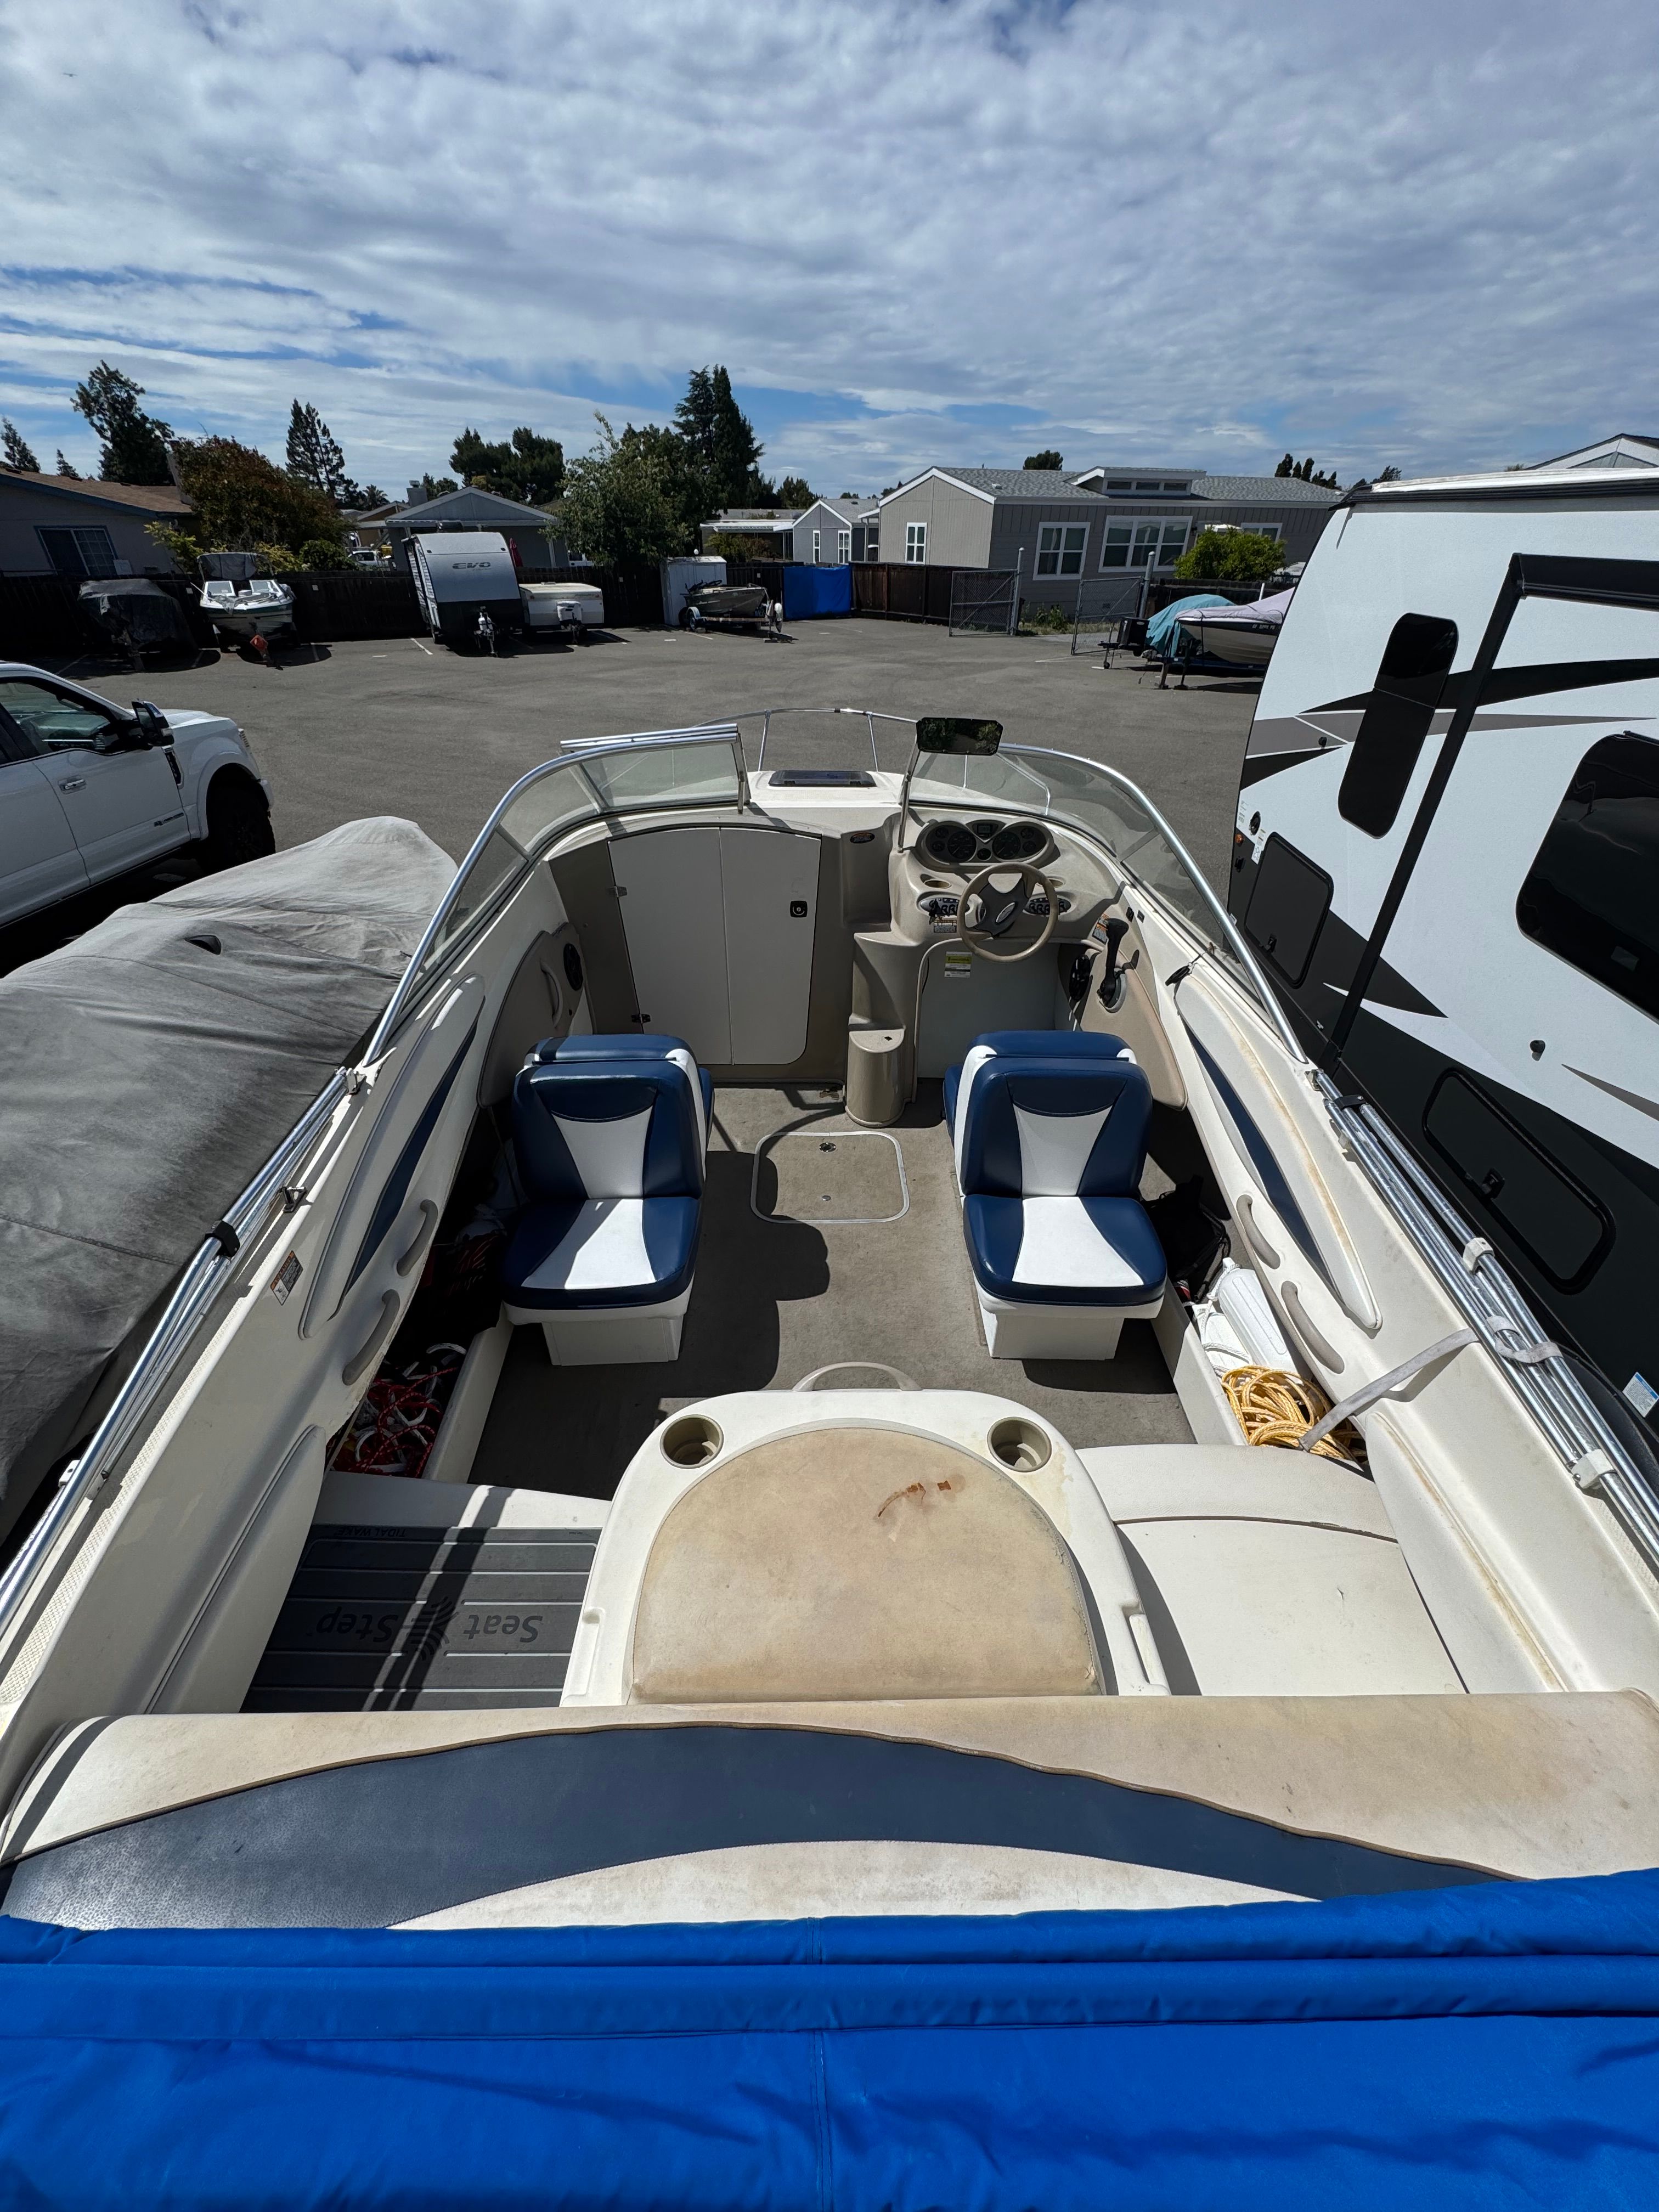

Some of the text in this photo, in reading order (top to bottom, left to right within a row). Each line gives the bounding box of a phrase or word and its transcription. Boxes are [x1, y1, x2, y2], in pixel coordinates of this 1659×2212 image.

[338, 1527, 406, 1537] TIDAL WAKE
[316, 1606, 543, 1643] Seat Step
